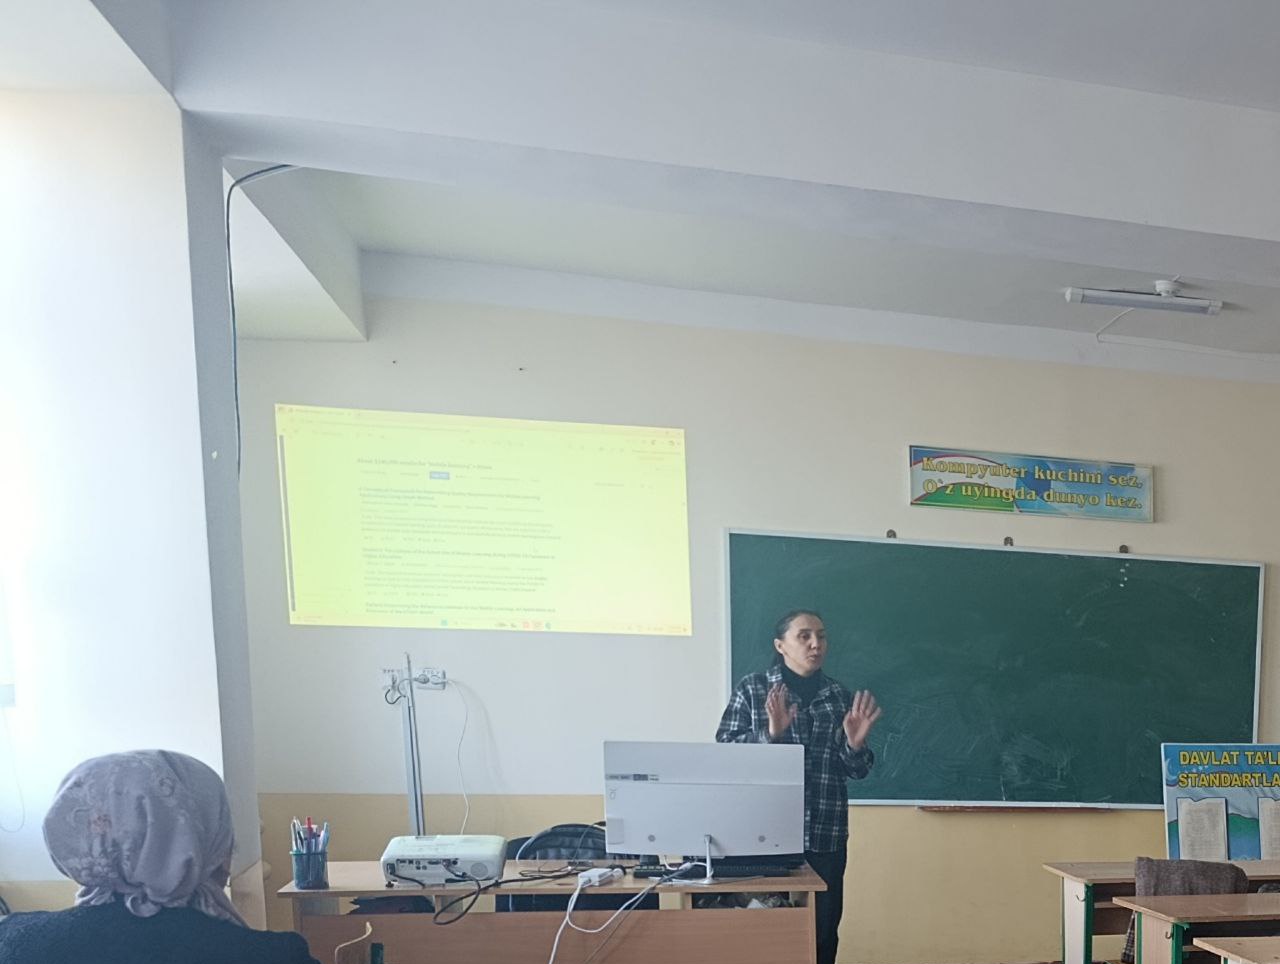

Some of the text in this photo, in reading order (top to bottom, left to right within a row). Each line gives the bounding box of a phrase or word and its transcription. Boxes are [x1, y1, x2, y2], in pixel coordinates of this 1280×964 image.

[922, 457, 1027, 479] Kompyuter
[962, 481, 1036, 504] uyingda
[1043, 488, 1100, 508] dunyo
[1179, 751, 1239, 765] DAVLAT
